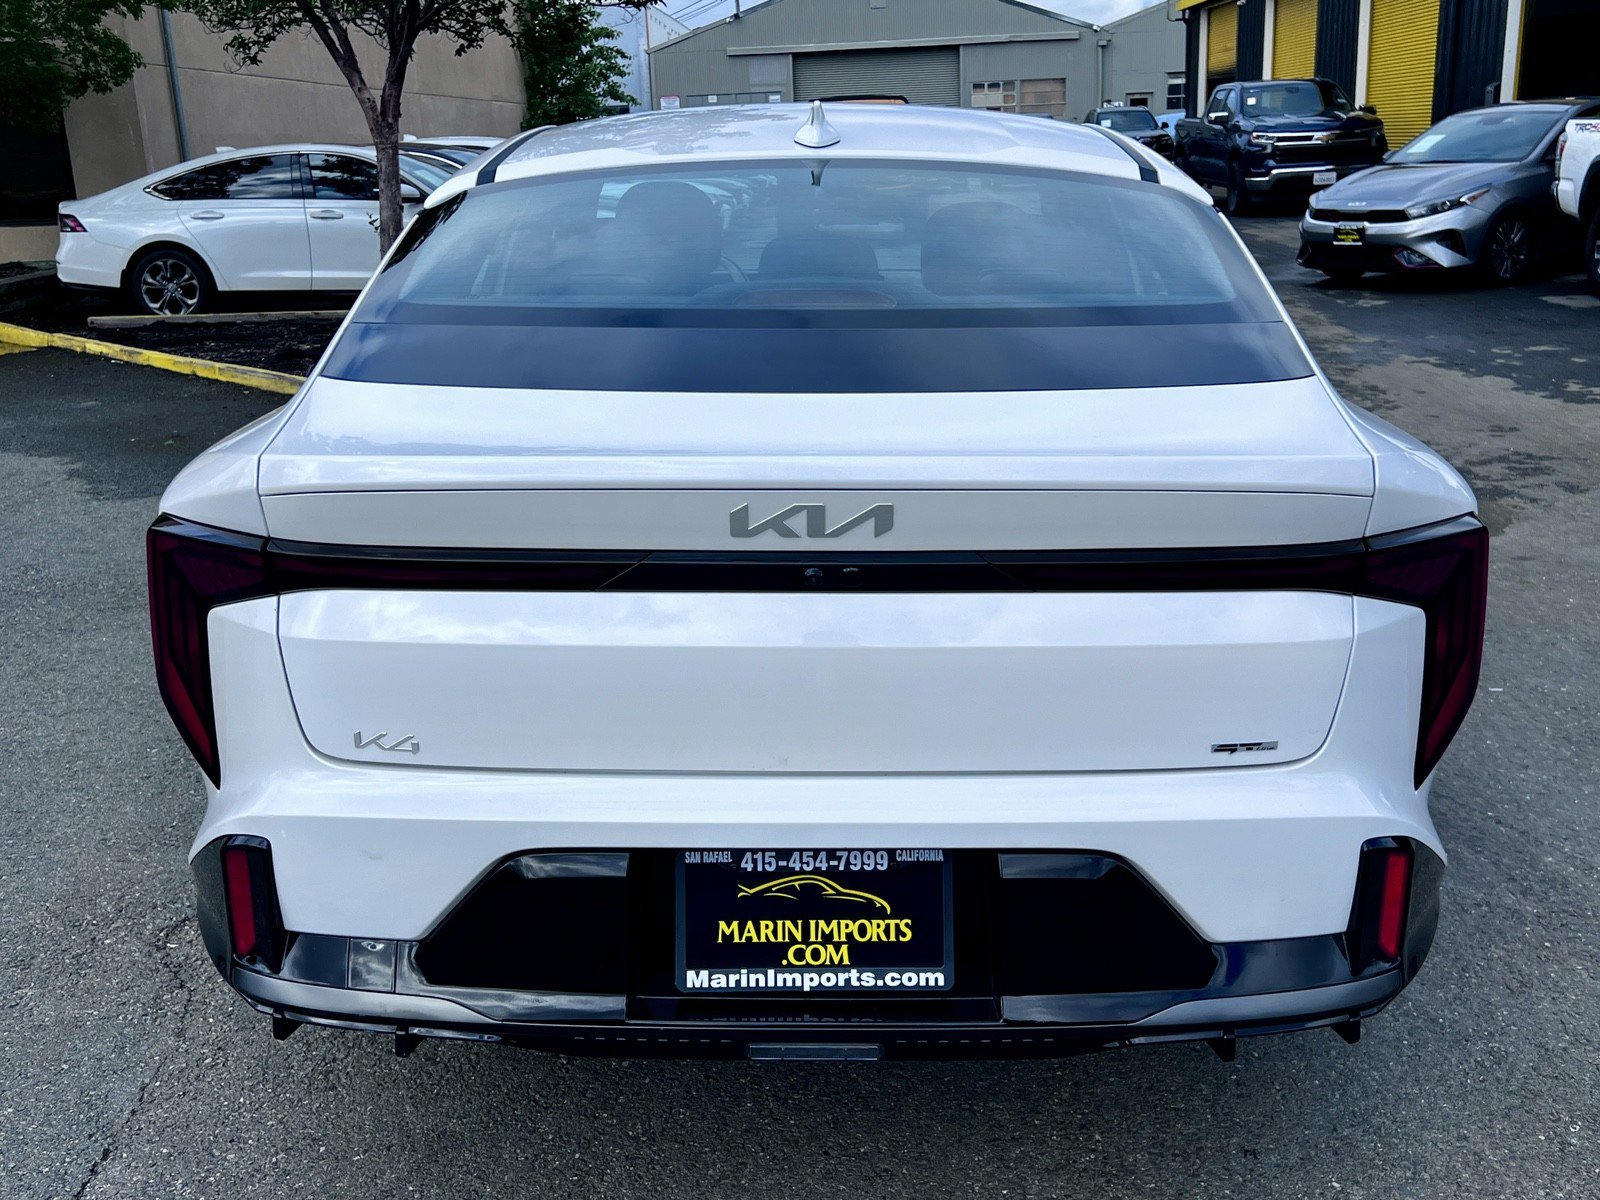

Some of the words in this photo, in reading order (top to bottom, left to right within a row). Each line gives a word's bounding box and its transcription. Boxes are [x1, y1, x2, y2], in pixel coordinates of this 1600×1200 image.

[730, 502, 894, 538] KIA
[353, 730, 420, 755] K4
[685, 851, 701, 864] SAN
[702, 851, 733, 863] RAFAEL
[740, 850, 889, 872] 415-454-7999
[895, 849, 944, 862] CALIFORNIA
[717, 919, 803, 943] MARIN
[809, 918, 912, 942] IMPORTS
[781, 944, 851, 966] .COM
[686, 968, 945, 992] MarinImports.com
